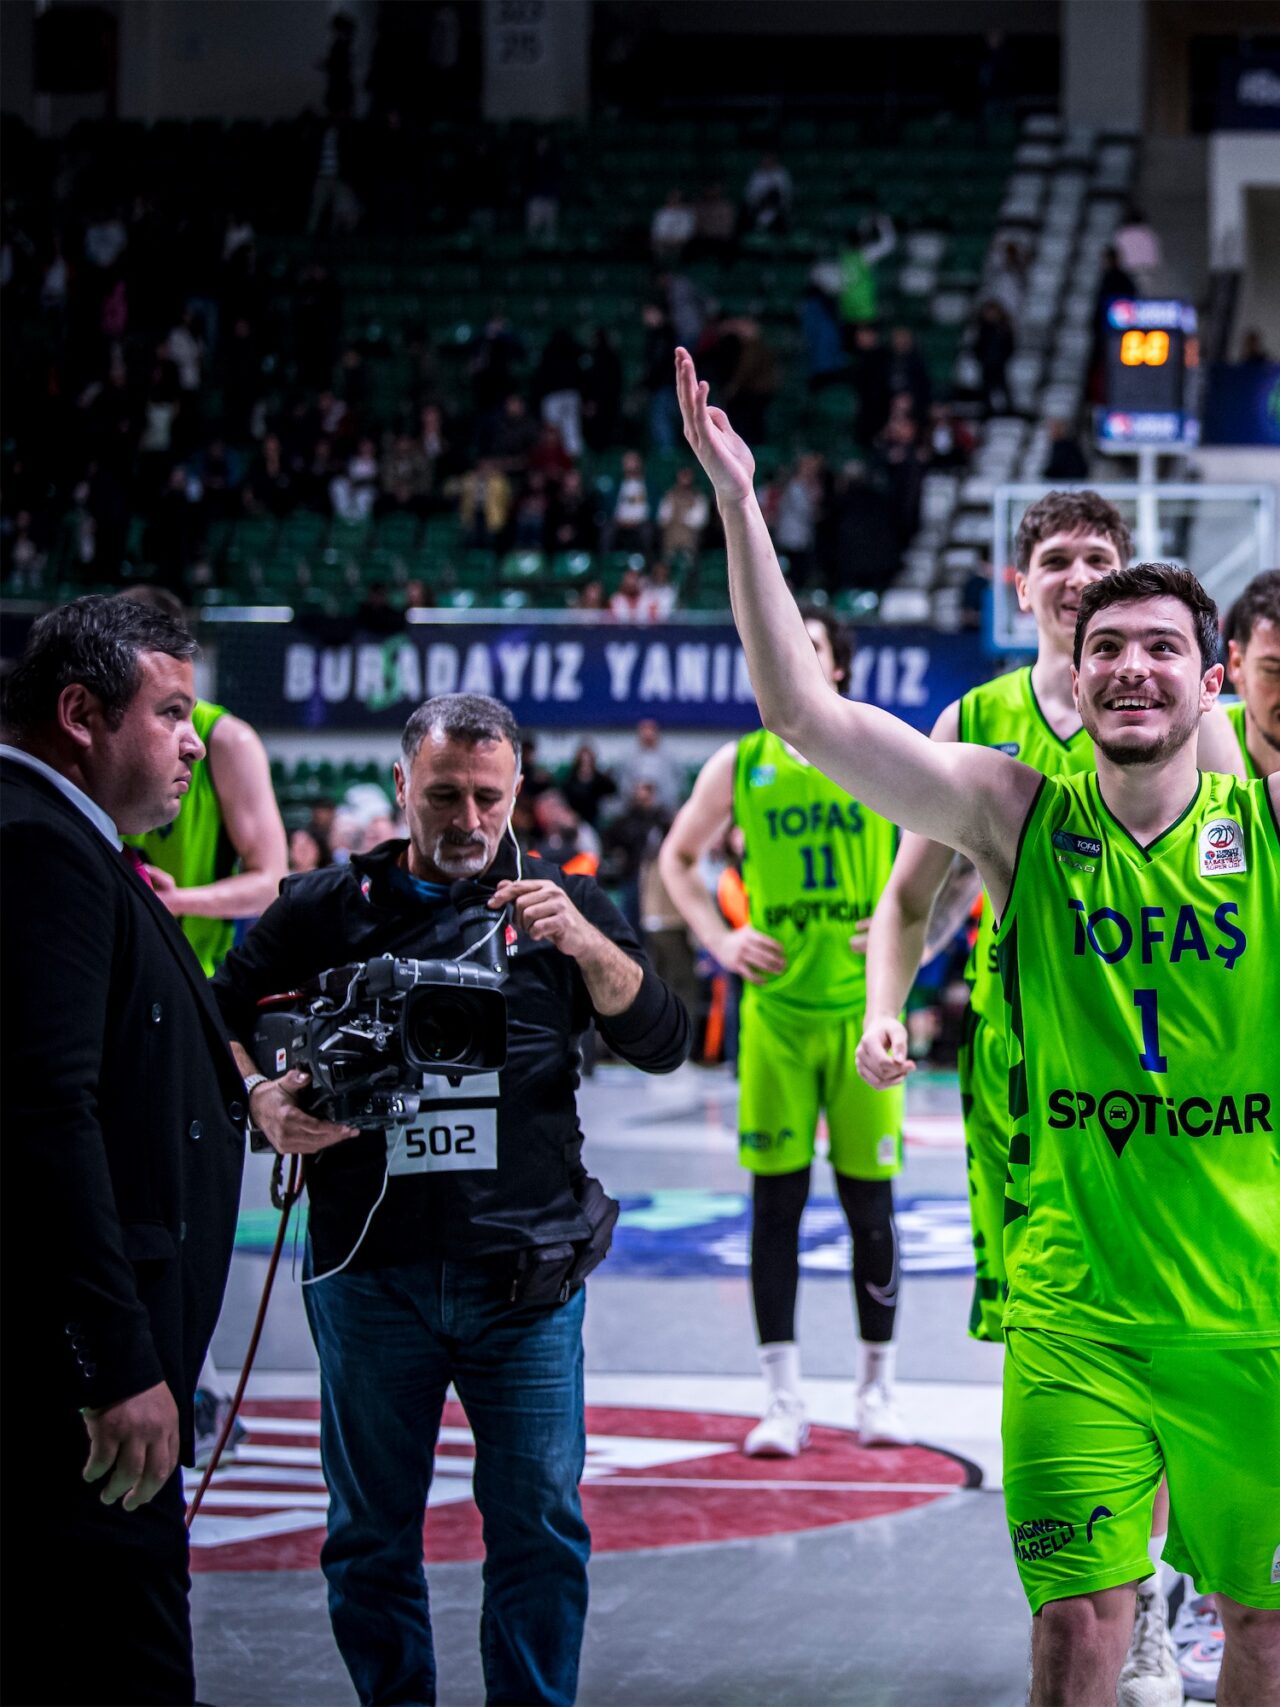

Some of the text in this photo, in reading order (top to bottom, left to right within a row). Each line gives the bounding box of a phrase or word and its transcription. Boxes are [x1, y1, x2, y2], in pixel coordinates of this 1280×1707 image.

[800, 845, 837, 889] 11
[1068, 898, 1248, 971] TOFAŞ
[1133, 989, 1169, 1074] 1
[404, 1124, 477, 1159] 502
